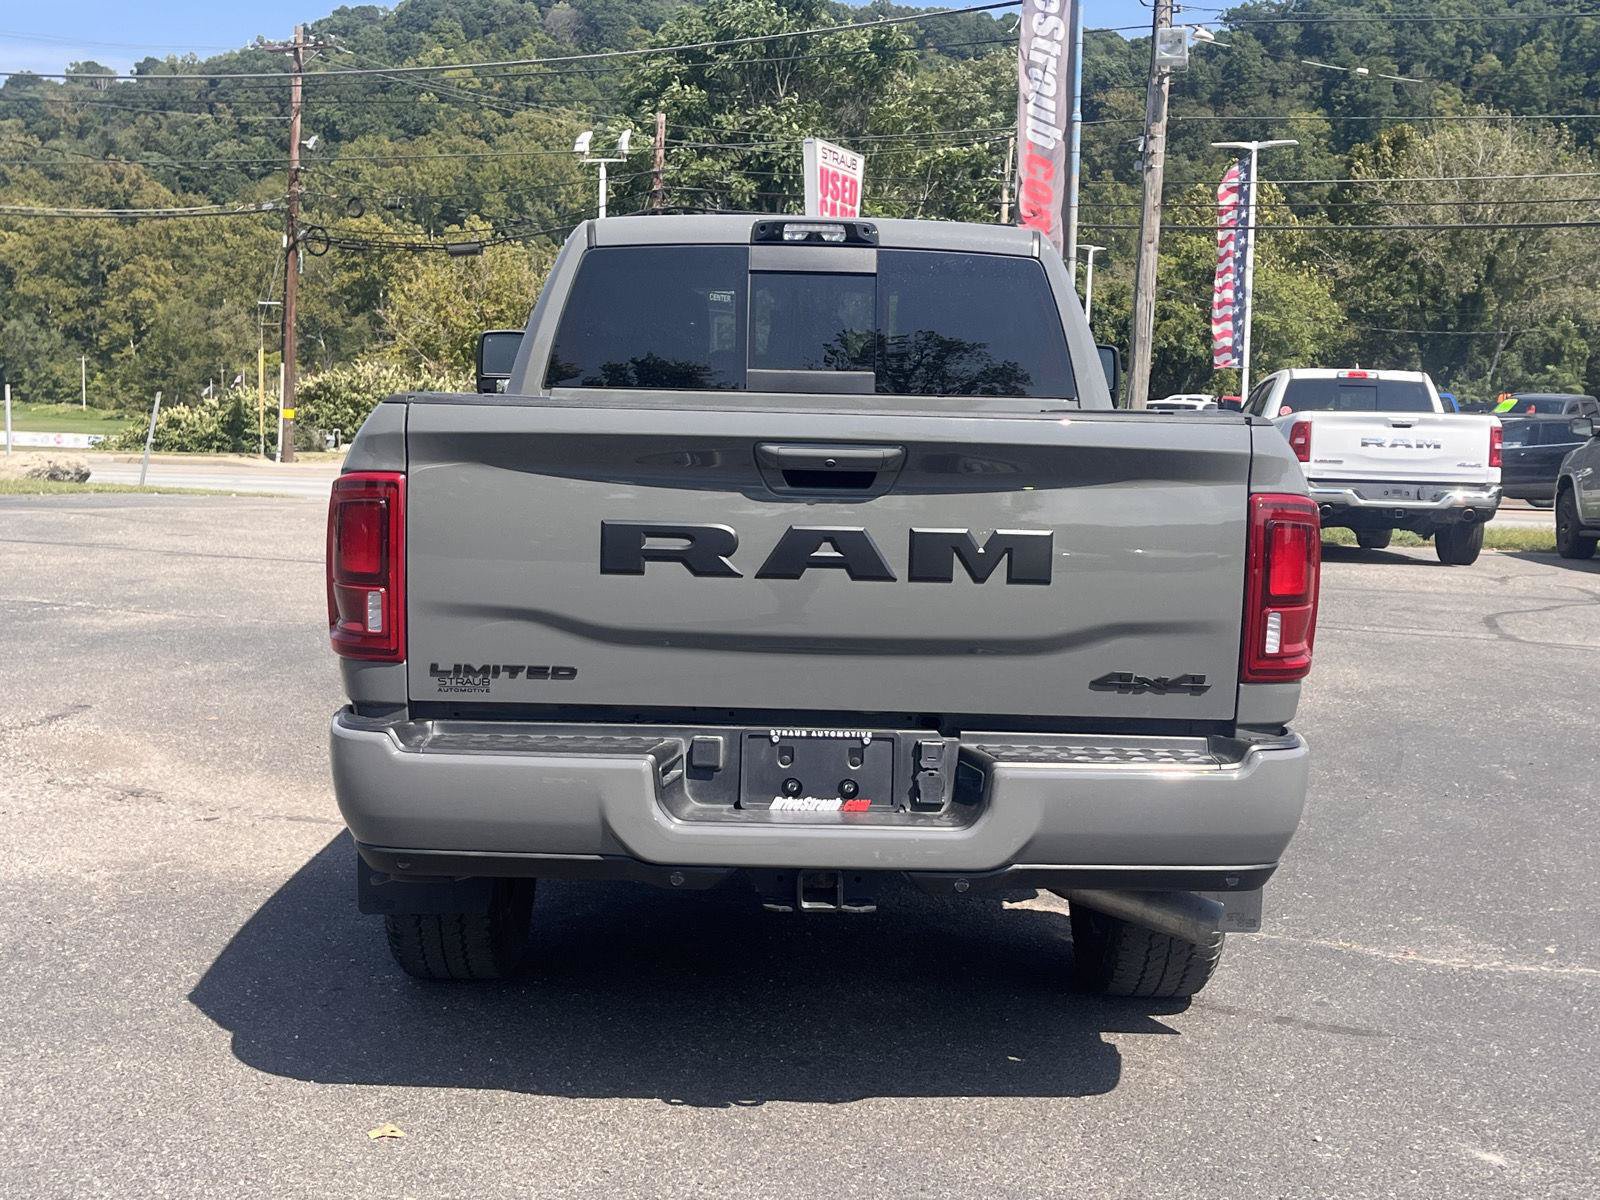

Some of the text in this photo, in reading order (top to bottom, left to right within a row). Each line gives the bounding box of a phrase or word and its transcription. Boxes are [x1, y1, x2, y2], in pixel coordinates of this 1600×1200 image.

[821, 146, 858, 171] STRAUB
[819, 166, 858, 208] USED
[1360, 437, 1442, 450] RAM
[600, 519, 1053, 585] RAM
[429, 663, 577, 680] LIMITED
[437, 676, 491, 687] STRAUB
[769, 729, 807, 737] STRAUB
